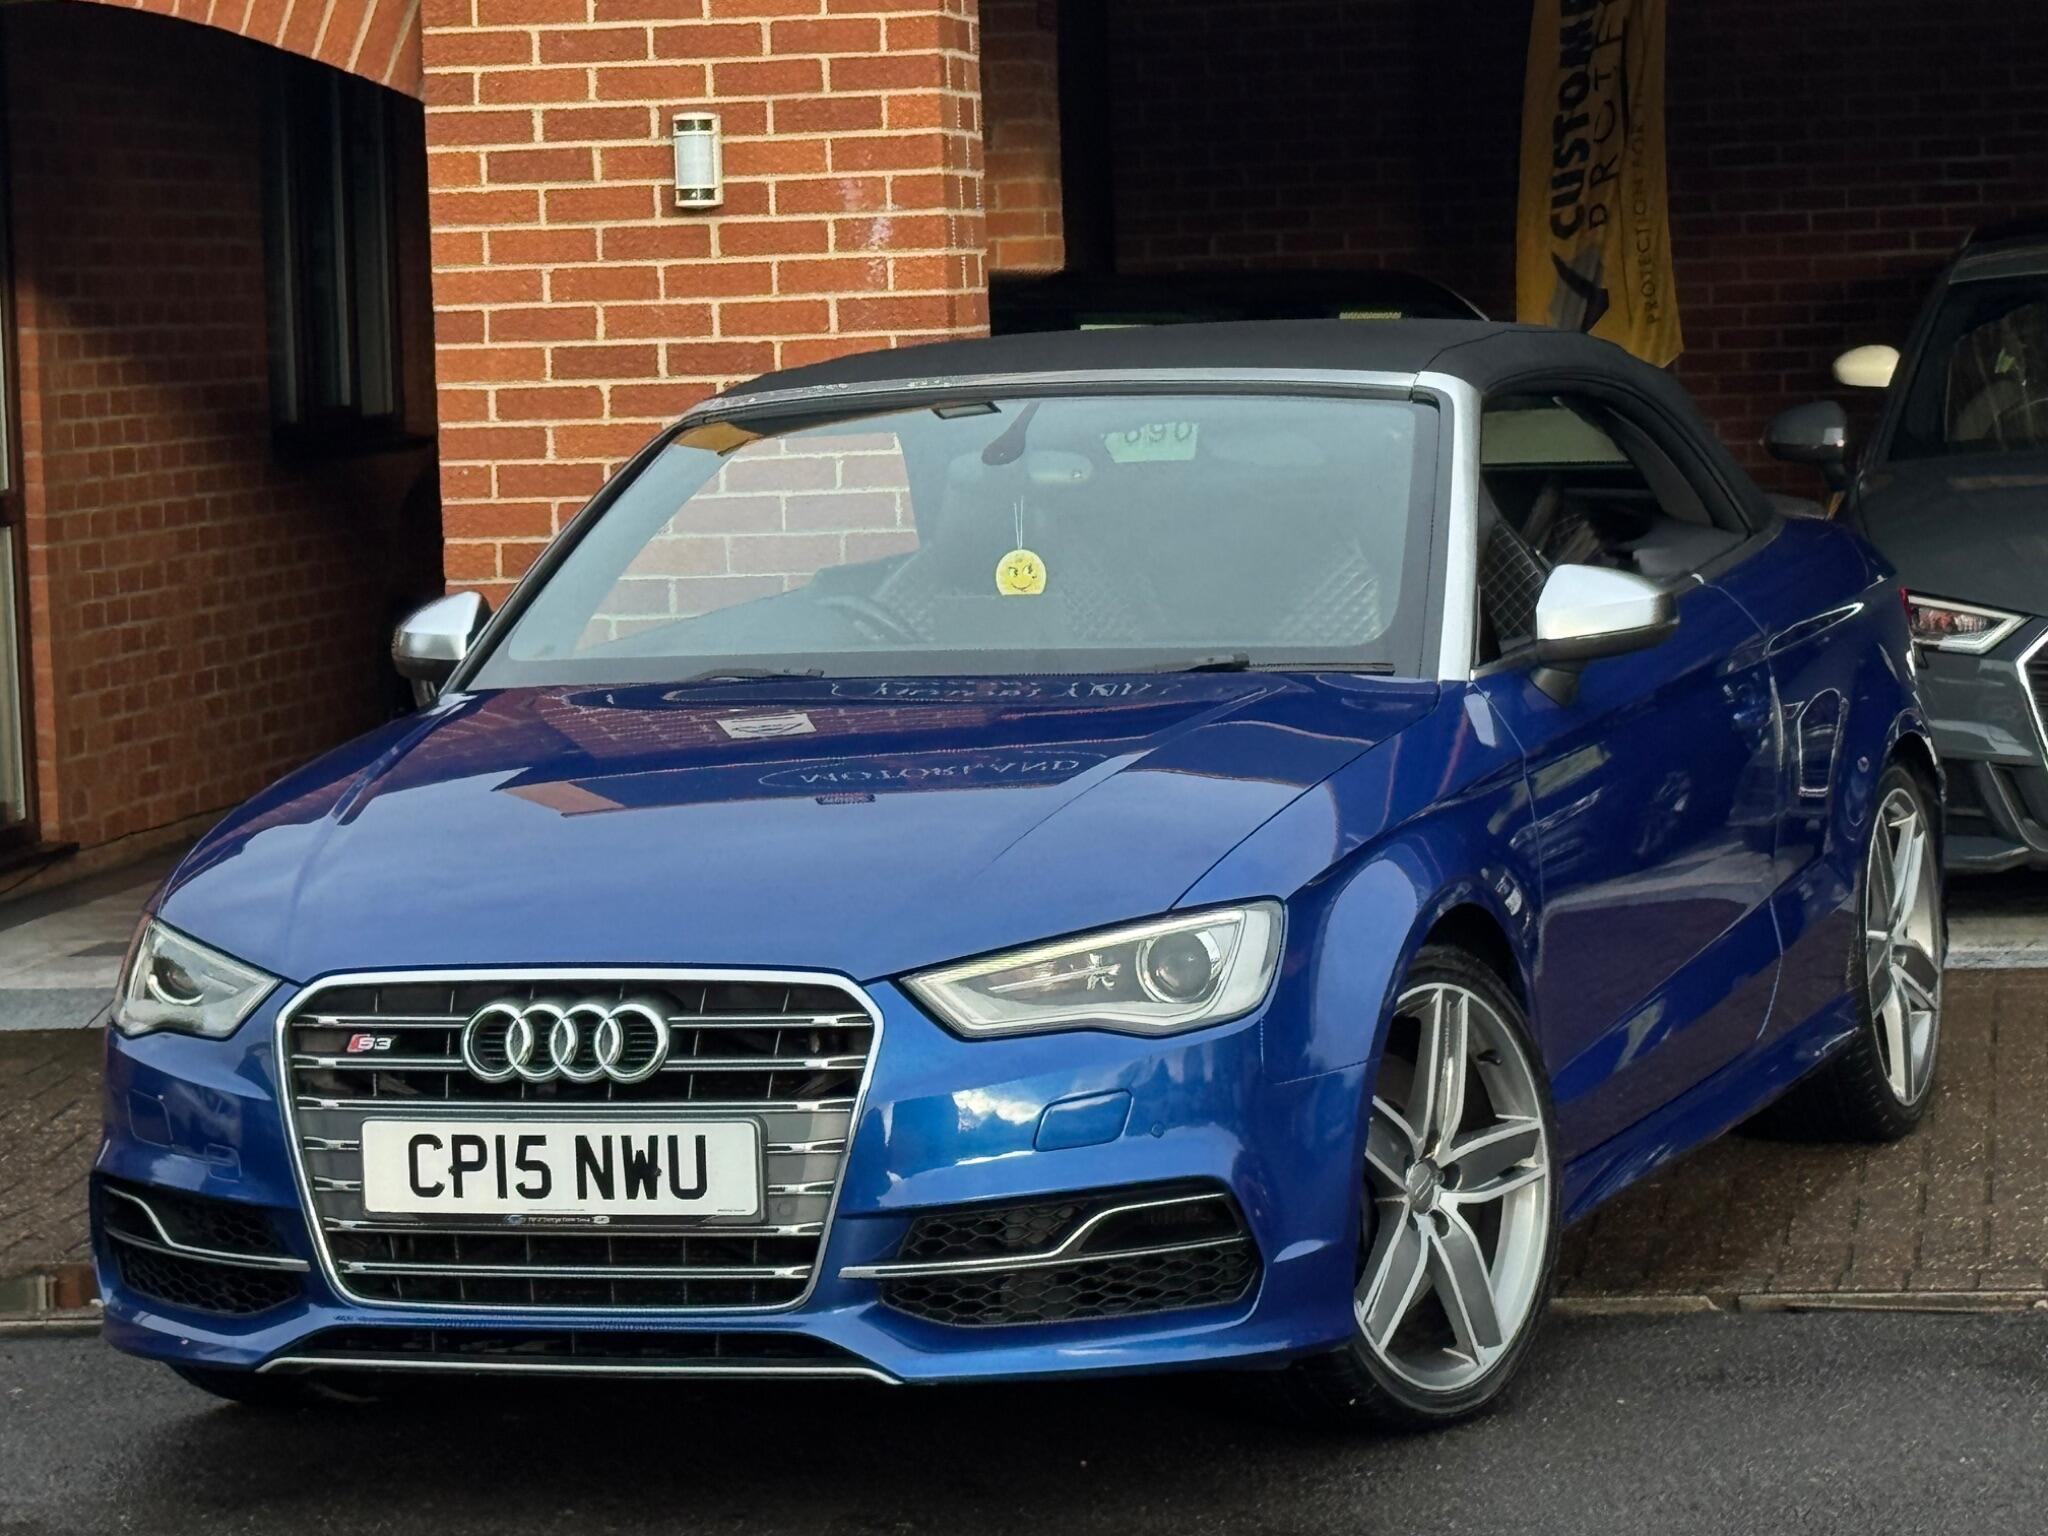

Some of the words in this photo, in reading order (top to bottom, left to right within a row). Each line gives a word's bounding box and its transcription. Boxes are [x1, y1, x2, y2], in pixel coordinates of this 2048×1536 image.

[349, 1034, 393, 1052] S3
[408, 1133, 552, 1199] CP15
[575, 1134, 708, 1200] NWU
